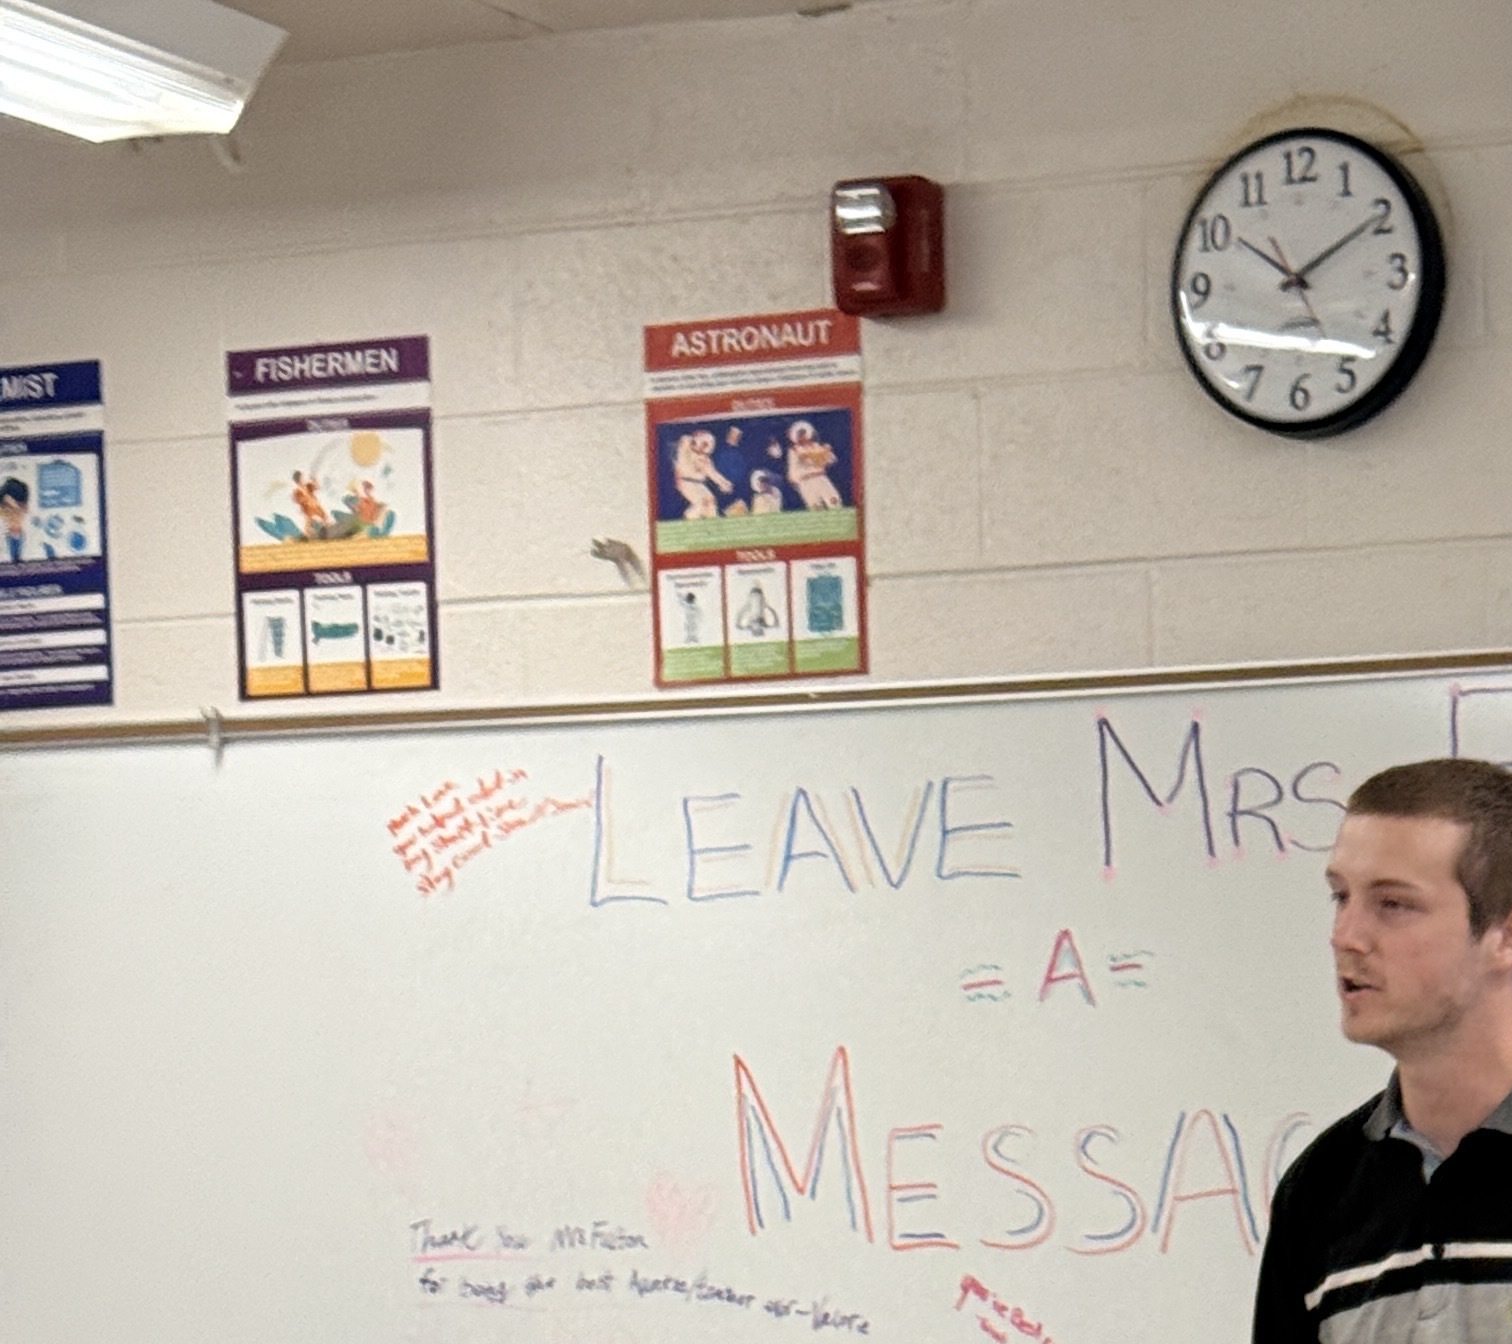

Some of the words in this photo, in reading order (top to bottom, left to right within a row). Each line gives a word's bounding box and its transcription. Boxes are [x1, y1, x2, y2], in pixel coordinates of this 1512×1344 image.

[1283, 146, 1318, 185] 12
[1338, 161, 1353, 198] 1
[1240, 171, 1268, 208] 11
[1200, 213, 1231, 252] 10
[1372, 197, 1393, 236] 2
[1189, 272, 1211, 310] 9
[1386, 252, 1408, 291] 3
[671, 319, 832, 358] ASTRONAUT
[1372, 309, 1393, 344] 4
[255, 347, 399, 383] FISHERMEN
[1246, 363, 1265, 402] 7
[1335, 355, 1357, 395] 5
[1289, 373, 1312, 411] 6
[589, 754, 1021, 907] LEAVE
